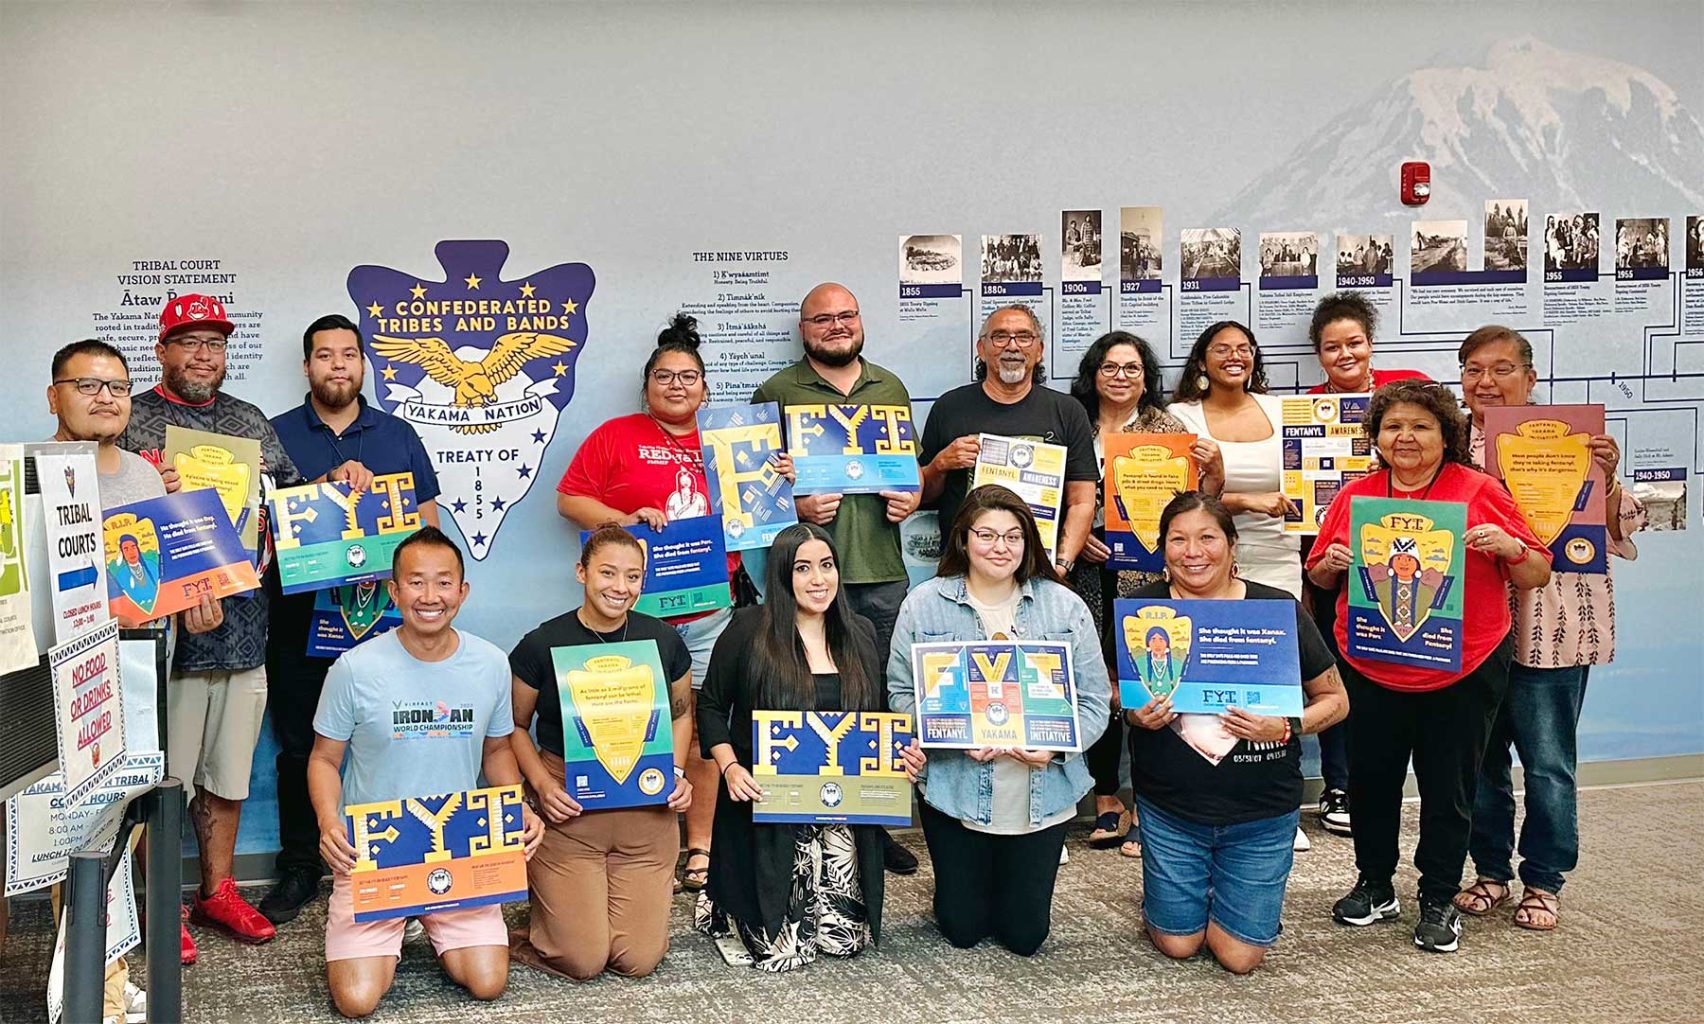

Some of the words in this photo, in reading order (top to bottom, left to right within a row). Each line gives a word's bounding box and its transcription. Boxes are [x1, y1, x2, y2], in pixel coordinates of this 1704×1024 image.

[693, 252, 714, 262] THE
[716, 252, 743, 261] NINE
[745, 251, 788, 261] VIRTUES
[133, 261, 177, 271] TRIBAL
[180, 260, 221, 270] COURT
[1546, 271, 1563, 281] 1955
[1617, 270, 1634, 279] 1955
[1687, 268, 1703, 278] 1956
[117, 275, 160, 285] VISION
[164, 273, 236, 284] STATEMENT
[1338, 276, 1375, 286] 1940-1950
[983, 285, 1007, 295] 1880s
[1064, 284, 1087, 293] 1900s
[1122, 282, 1140, 291] 1927
[1182, 281, 1200, 290] 1931
[901, 287, 921, 297] 1855
[396, 299, 551, 317] CONFEDERATED
[93, 313, 109, 321] The
[110, 312, 142, 321] Yakama
[144, 312, 161, 321] Nat
[226, 310, 263, 320] mmunity
[95, 323, 122, 332] rooted
[123, 323, 132, 331] in
[378, 318, 443, 333] TRIBES
[456, 316, 496, 332] AND
[507, 315, 570, 331] BANDS
[118, 334, 147, 342] secure,
[238, 341, 248, 349] of
[231, 352, 263, 361] identity
[720, 353, 728, 361] 4)
[234, 373, 247, 381] all.
[1618, 381, 1634, 399] 1950
[408, 404, 471, 422] YAKAMA
[485, 399, 540, 420] NATION
[784, 404, 917, 458] FYI
[1285, 427, 1323, 437] FENTANYL
[1045, 431, 1054, 443] 2
[437, 450, 493, 463] TREATY
[497, 449, 519, 461] OF
[1526, 453, 1545, 461] people
[981, 465, 1016, 481] FENTANYL
[1635, 470, 1671, 481] 1940-1950
[56, 503, 92, 526] TRIBAL
[265, 471, 422, 554] FYI
[1390, 516, 1424, 531] FYI
[58, 532, 96, 559] COURTS
[663, 542, 685, 551] thought
[664, 550, 677, 558] died
[676, 549, 690, 557] from
[659, 594, 686, 609] FYI
[1198, 627, 1211, 635] She
[1211, 627, 1239, 638] thought
[1261, 629, 1287, 637] Xanax.
[1356, 624, 1380, 633] thought
[1228, 636, 1245, 644] from
[1246, 637, 1277, 647] fentanyl.
[1422, 632, 1436, 640] died
[1437, 634, 1453, 642] from
[1424, 640, 1453, 651] Fentanyl
[72, 664, 85, 685] NO
[85, 652, 106, 677] FOOD
[70, 697, 82, 719] OR
[82, 679, 112, 711] DRINKS
[1202, 689, 1237, 704] FYI
[77, 710, 112, 747] ALLOWED
[393, 724, 419, 733] WORLD
[419, 724, 474, 733] CHAMPIONSHIP
[927, 727, 968, 740] FENTANYL
[981, 729, 1018, 740] YAKAMA
[1029, 730, 1073, 744] INITIATIVE
[752, 709, 912, 779] FYI
[115, 774, 149, 786] TRIBAL
[90, 791, 126, 804] HOURS
[70, 824, 83, 832] AM
[345, 784, 526, 875] FYI
[32, 850, 62, 863] LUNCH
